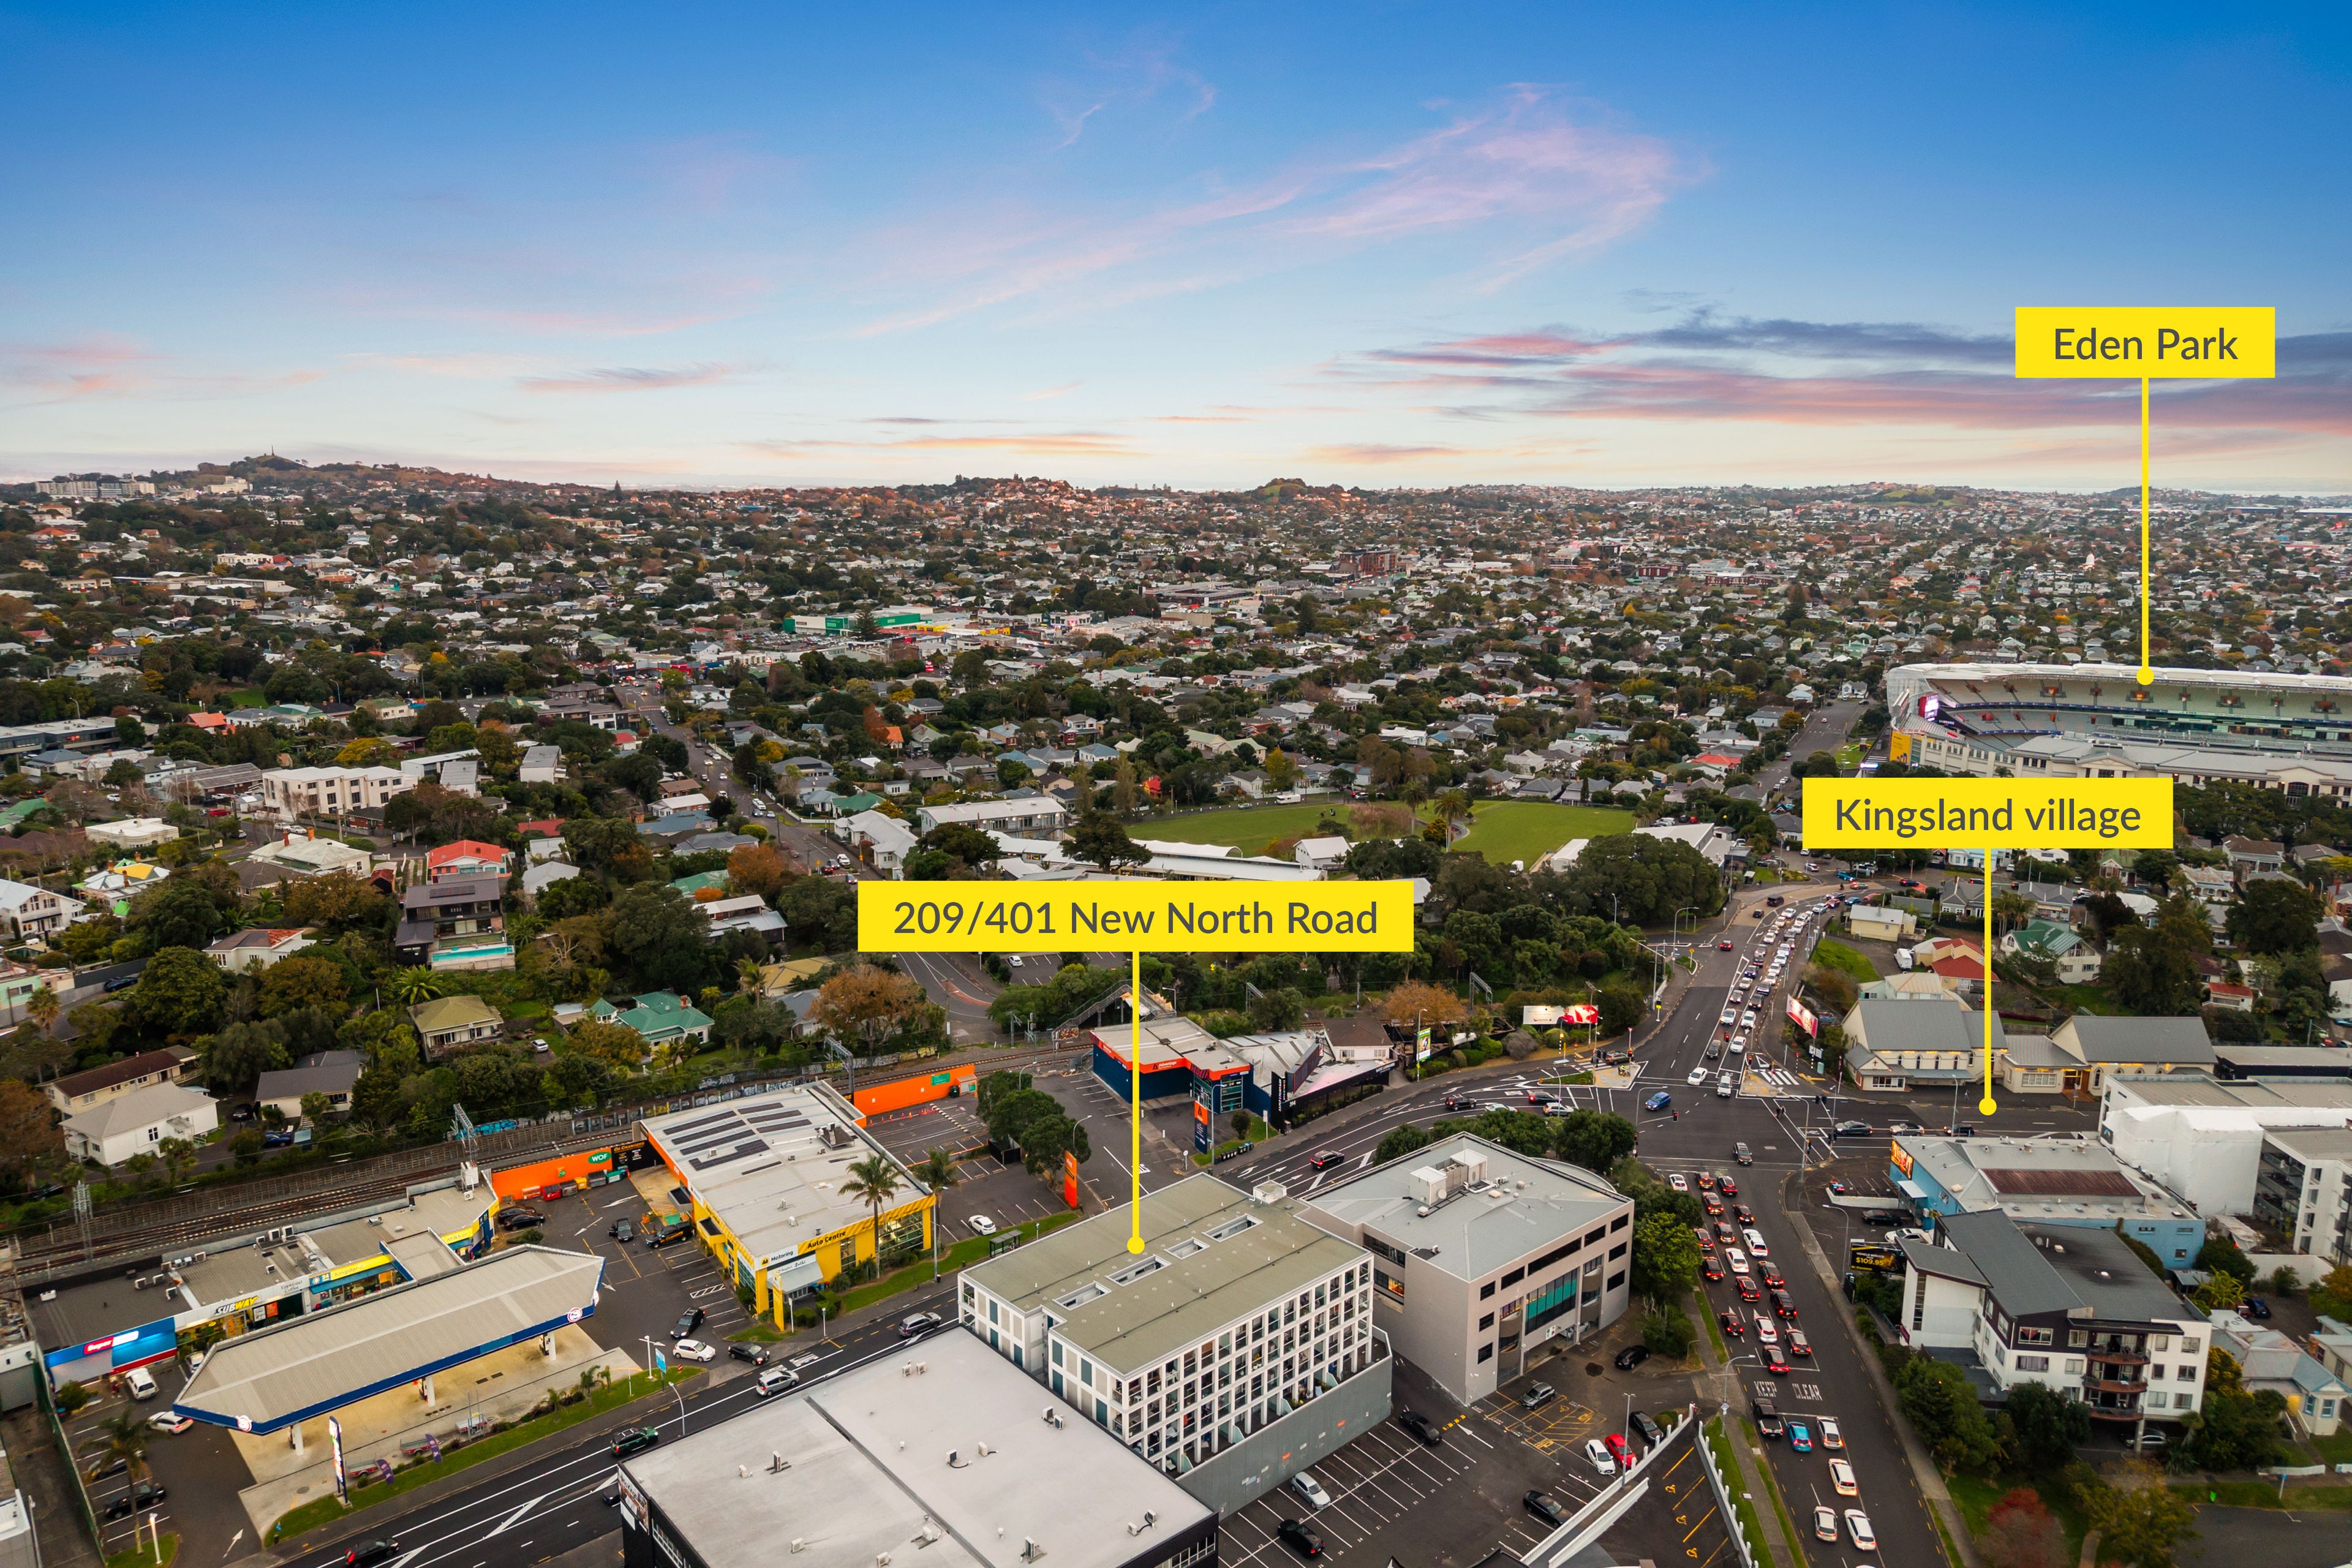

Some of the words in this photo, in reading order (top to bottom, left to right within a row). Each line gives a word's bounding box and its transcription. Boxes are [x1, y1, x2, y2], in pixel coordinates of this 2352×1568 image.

[592, 1153, 608, 1162] WOF
[807, 1239, 824, 1249] Auto
[824, 1231, 846, 1242] Centre
[771, 1250, 794, 1262] Motoring
[1855, 1257, 1884, 1266] $109.95
[334, 1264, 364, 1277] Kingsland
[214, 1295, 259, 1316] SUBWAY
[1754, 1381, 1777, 1397] KEEP
[1792, 1383, 1823, 1401] CLEAR
